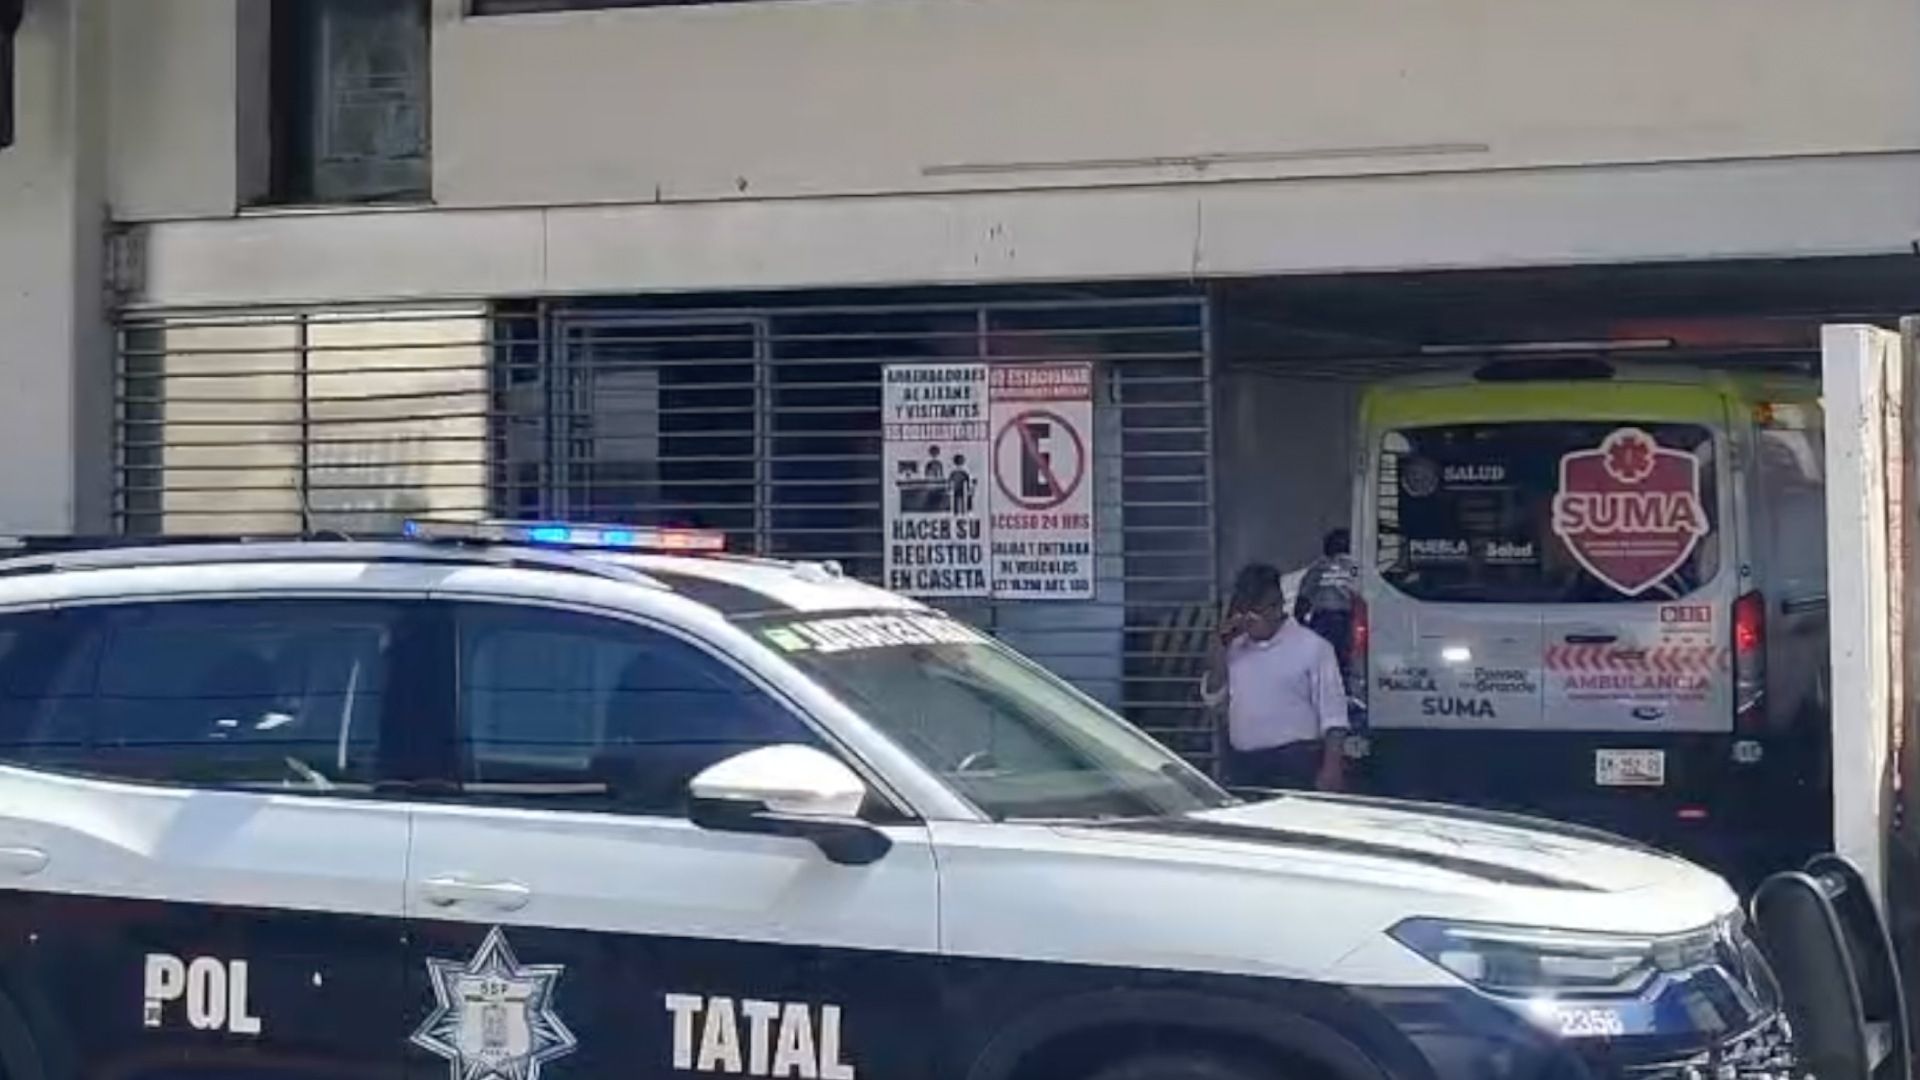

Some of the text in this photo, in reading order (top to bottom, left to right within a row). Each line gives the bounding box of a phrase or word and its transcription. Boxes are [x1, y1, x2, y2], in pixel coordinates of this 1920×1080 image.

[896, 404, 979, 418] Y VISITANTES
[1444, 465, 1505, 481] SALUD
[1041, 515, 1058, 530] 24
[1561, 496, 1698, 529] SUMA
[892, 518, 981, 540] HACER SU
[892, 544, 982, 565] REGISTRO
[1487, 542, 1533, 557] Salud
[890, 569, 986, 591] EN CASETA
[1565, 675, 1711, 690] AMBULANCIA
[1421, 697, 1496, 718] SUMA
[144, 953, 261, 1034] POL
[665, 992, 856, 1080] TATAL
